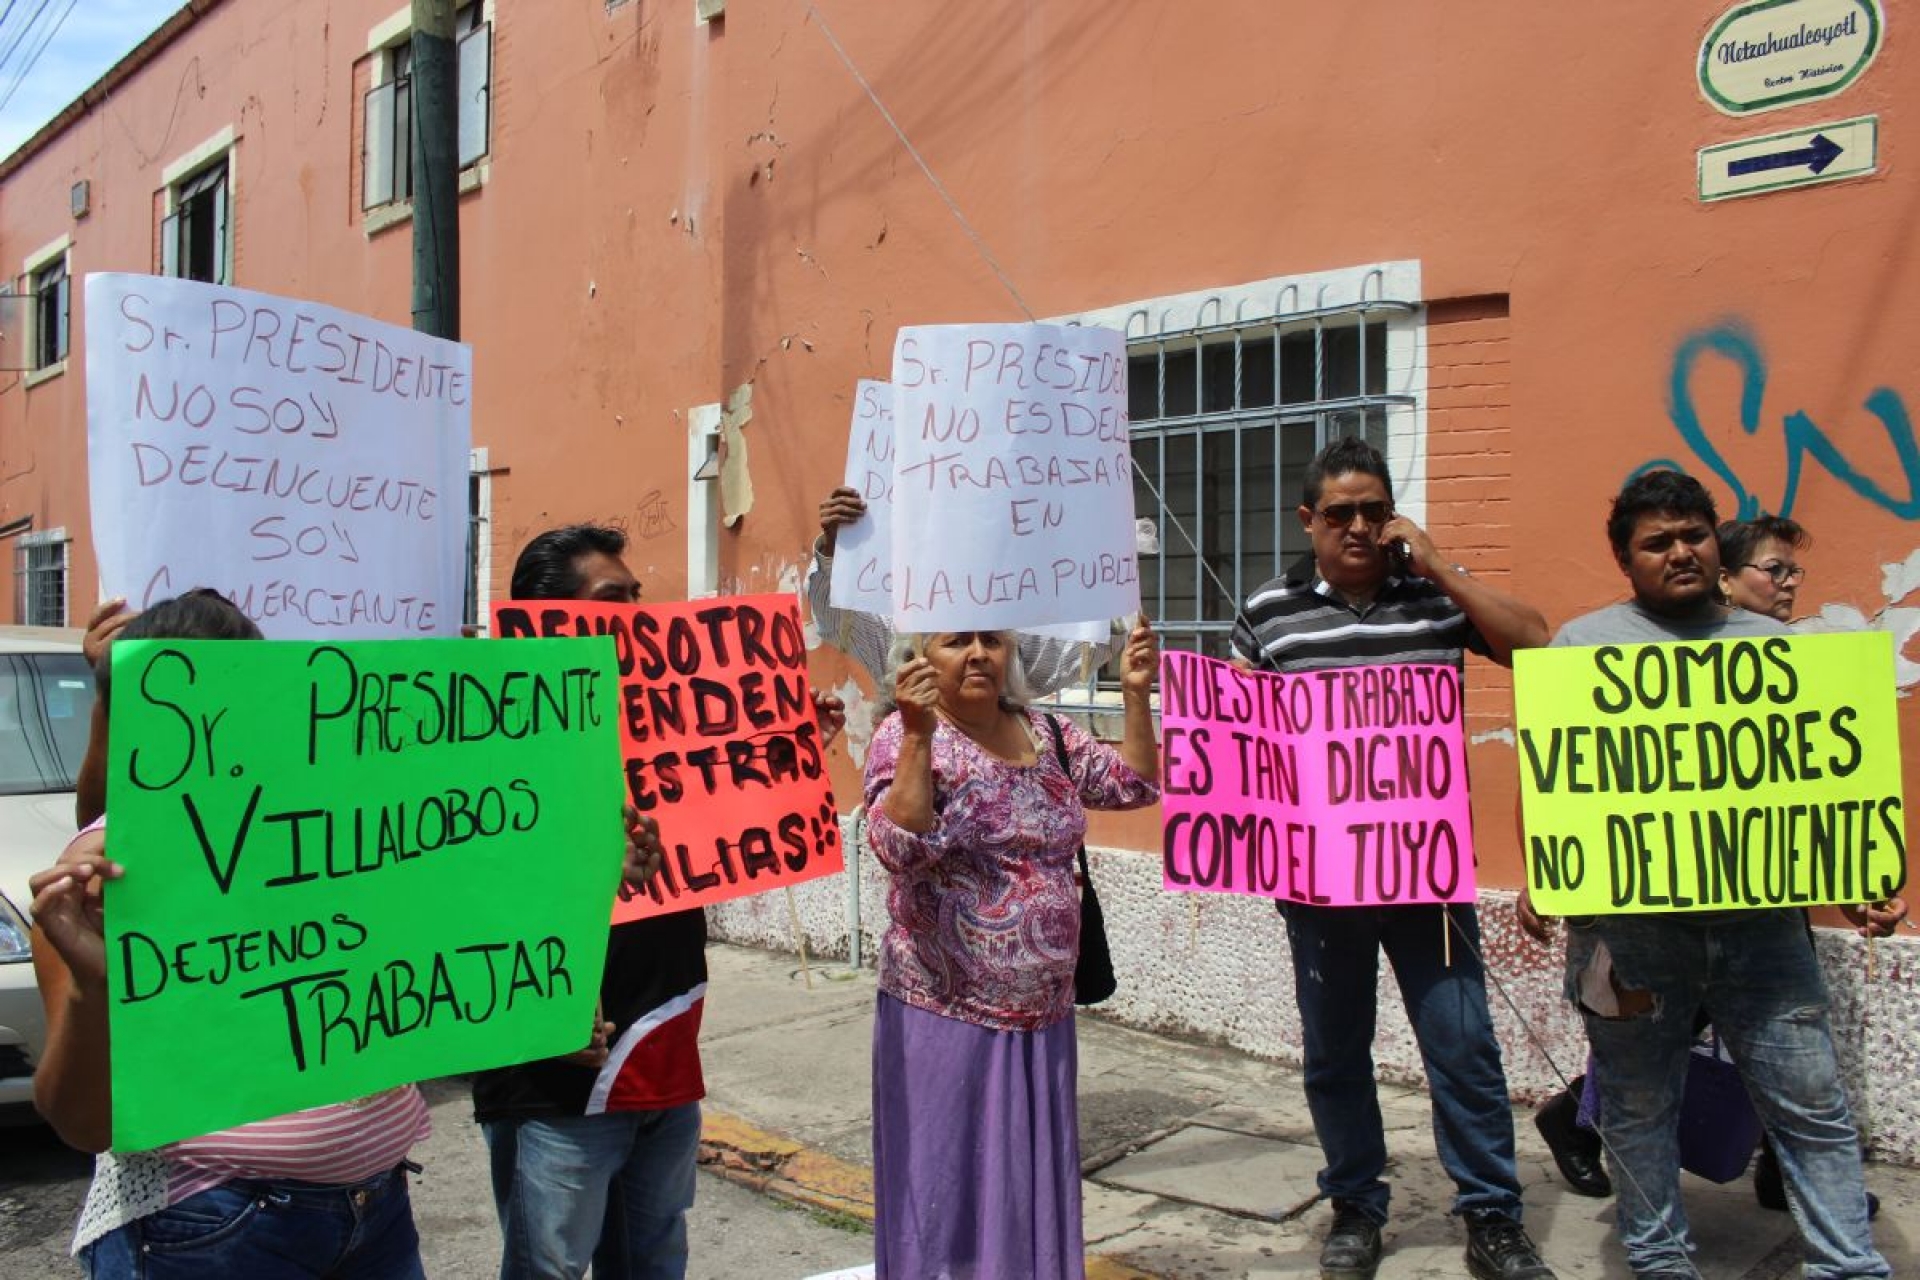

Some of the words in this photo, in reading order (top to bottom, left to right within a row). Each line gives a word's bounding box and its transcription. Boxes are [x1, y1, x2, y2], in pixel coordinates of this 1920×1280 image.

[120, 293, 192, 354] Sr.
[210, 299, 468, 406] PRESIDENTE
[899, 338, 948, 387] Sr.
[135, 372, 217, 428] NO
[230, 386, 338, 439] SOY
[922, 402, 980, 443] NO
[1006, 398, 1052, 435] ES
[131, 442, 438, 521] DELINCUENTE
[865, 428, 895, 463] N
[250, 515, 359, 564] SOY
[1011, 498, 1064, 537] EN
[142, 565, 436, 631] CMERCIANTE
[903, 566, 953, 611] LA
[622, 671, 806, 743] ENDEN
[1162, 653, 1313, 735] NUESTRO
[1316, 667, 1457, 732] TRABAJO
[1593, 637, 1799, 715] SOMOS
[129, 649, 244, 790] Sr.
[306, 646, 602, 765] PRESIDENTE
[1520, 706, 1862, 794] VENDEDORES
[624, 721, 822, 812] ESTRAS
[1164, 727, 1213, 796] ES
[1231, 732, 1300, 806] TAN
[1326, 734, 1452, 806] DIGNO
[182, 778, 540, 894] VILLALOBOS
[1163, 812, 1279, 893] COMO
[1286, 823, 1331, 904] EL
[1346, 818, 1460, 903] TUYO
[1530, 835, 1585, 891] NO
[1606, 796, 1907, 908] DELINCUENTES
[118, 913, 367, 1004] DEJENOS
[240, 935, 573, 1072] TRABAJAR
